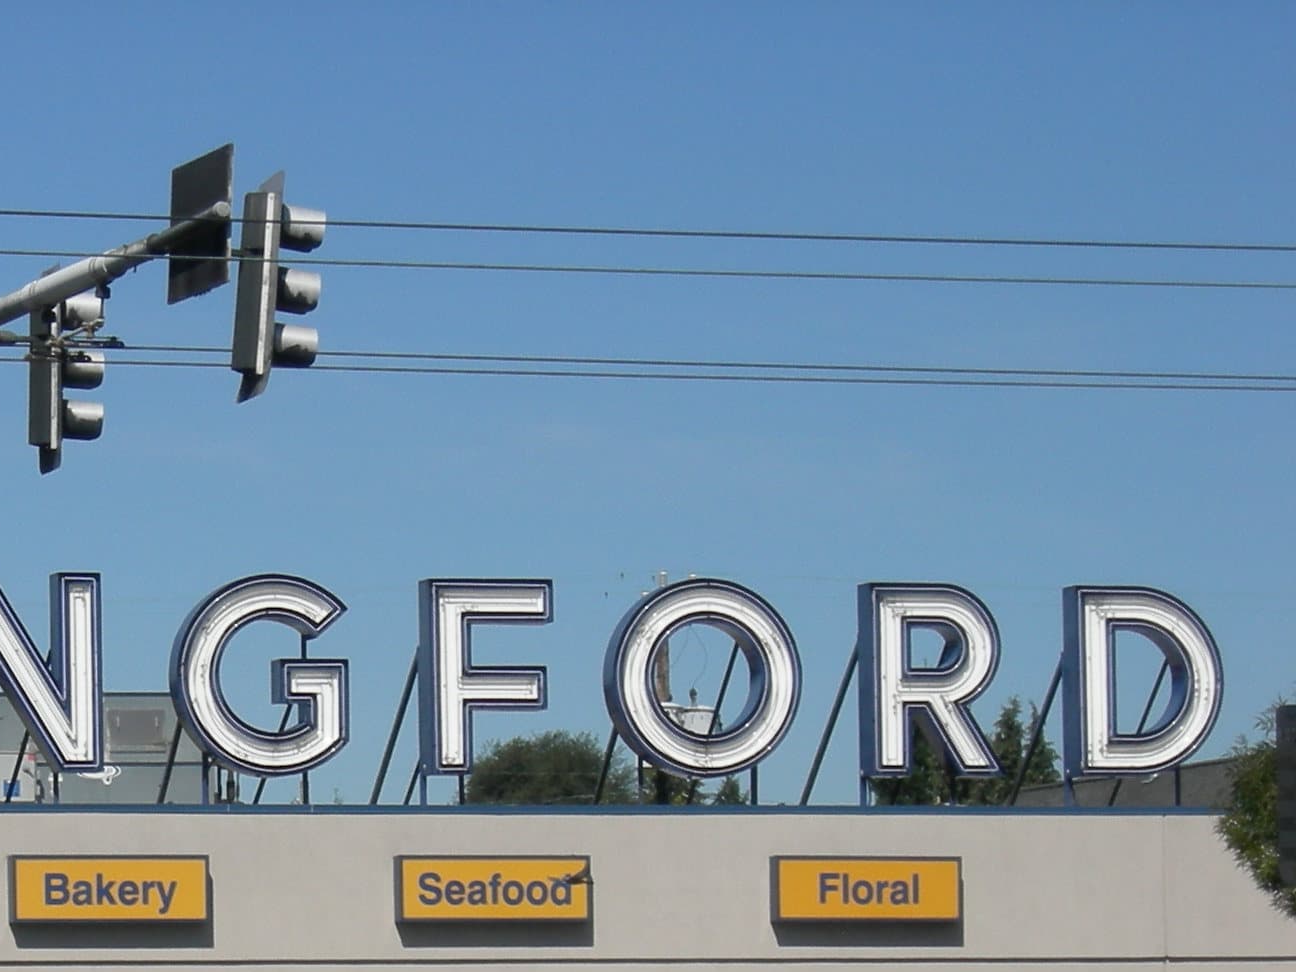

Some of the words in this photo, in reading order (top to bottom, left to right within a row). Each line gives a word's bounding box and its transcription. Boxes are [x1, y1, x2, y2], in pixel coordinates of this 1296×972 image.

[44, 872, 178, 914] Bakery
[418, 872, 572, 906] Seafood
[819, 872, 919, 905] Floral
